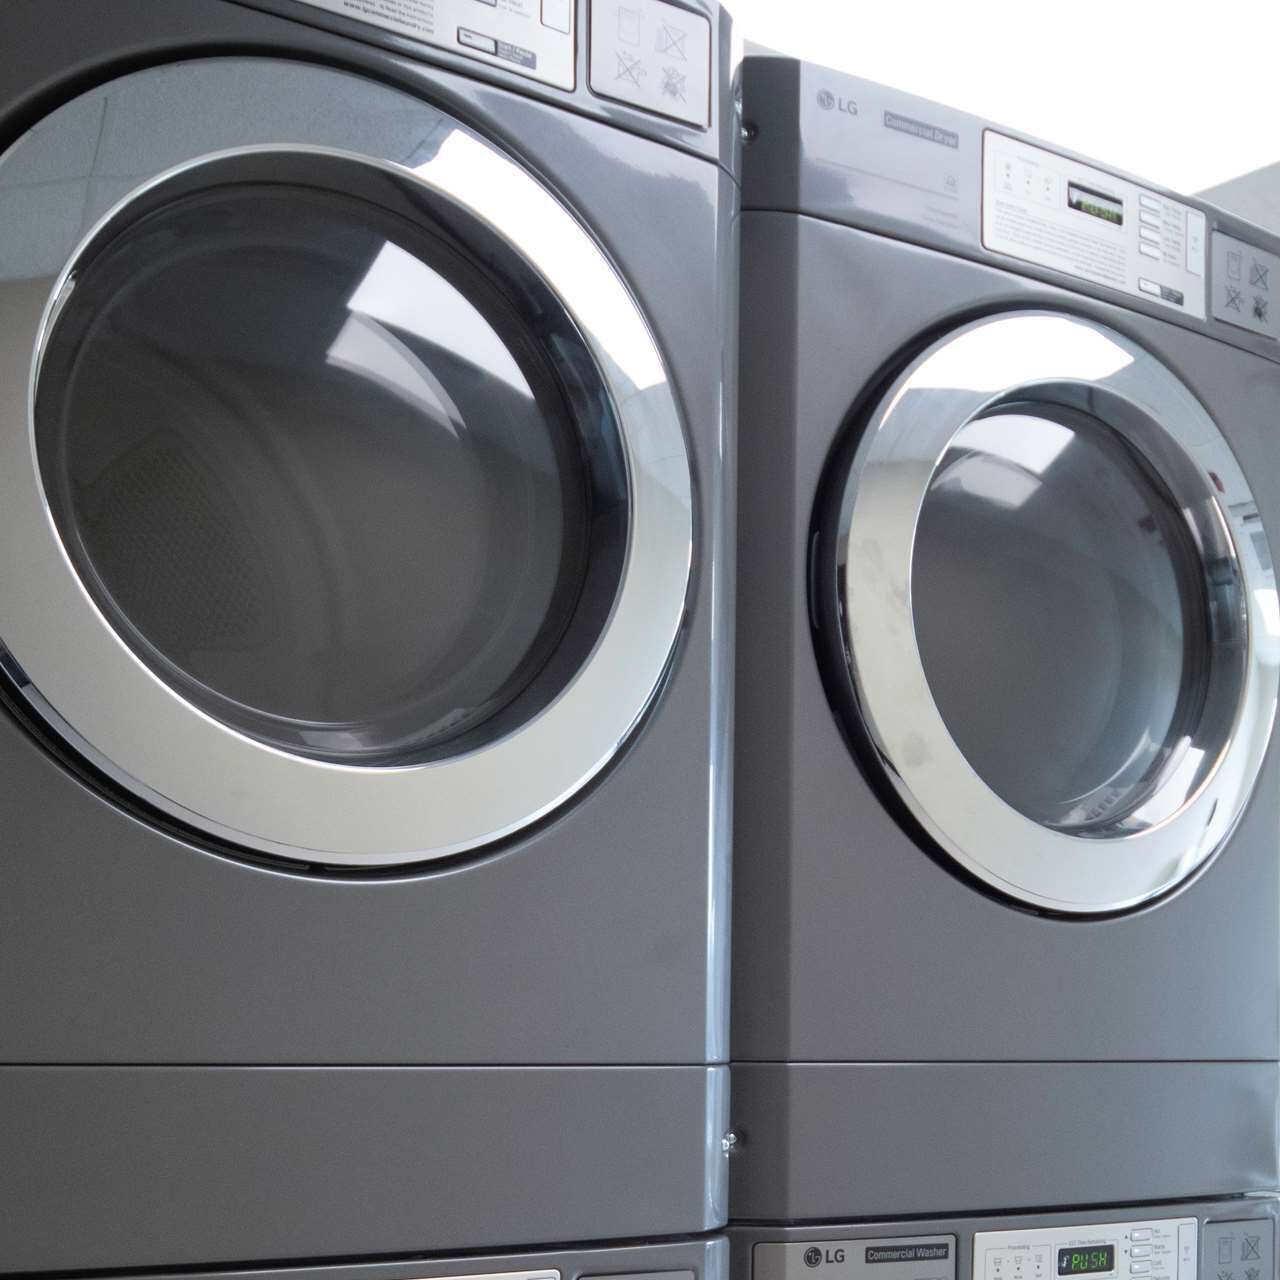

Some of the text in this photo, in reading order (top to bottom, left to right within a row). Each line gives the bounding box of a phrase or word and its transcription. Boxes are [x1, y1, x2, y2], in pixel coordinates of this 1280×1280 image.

[838, 98, 858, 116] LG
[825, 1249, 845, 1264] LG
[867, 1247, 946, 1261] Commercial Washer
[1071, 1251, 1107, 1270] PUSH
